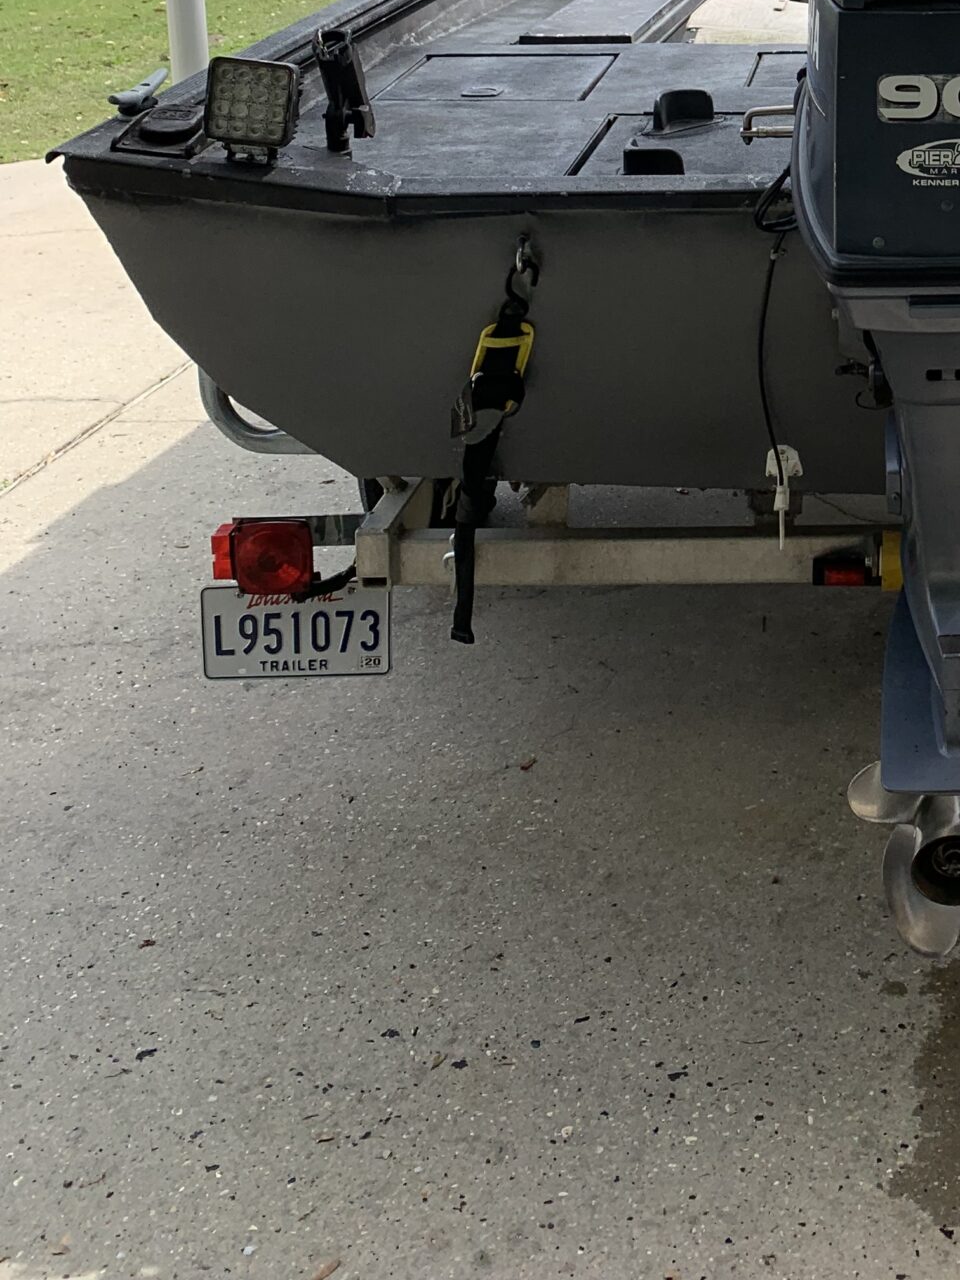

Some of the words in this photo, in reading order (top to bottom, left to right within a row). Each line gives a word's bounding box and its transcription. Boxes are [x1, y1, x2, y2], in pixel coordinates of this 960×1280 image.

[912, 149, 953, 167] PIER
[214, 609, 380, 656] L951073
[259, 659, 328, 672] TRAILER
